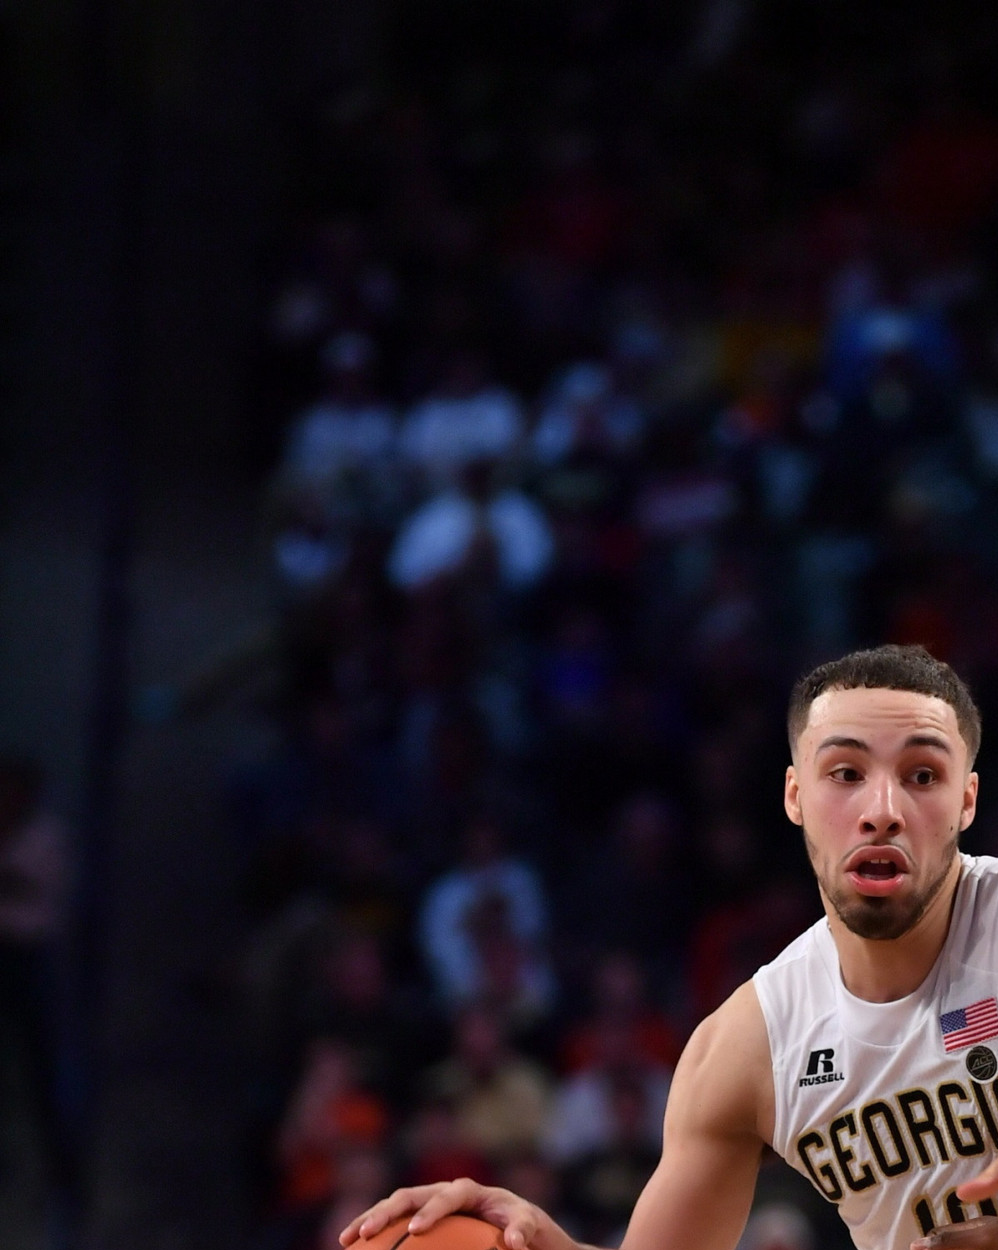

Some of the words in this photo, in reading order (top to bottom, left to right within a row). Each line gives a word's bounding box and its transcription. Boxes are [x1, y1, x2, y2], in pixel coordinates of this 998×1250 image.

[806, 1048, 835, 1075] R
[971, 1053, 994, 1069] ACC
[799, 1072, 845, 1087] RUSSELL
